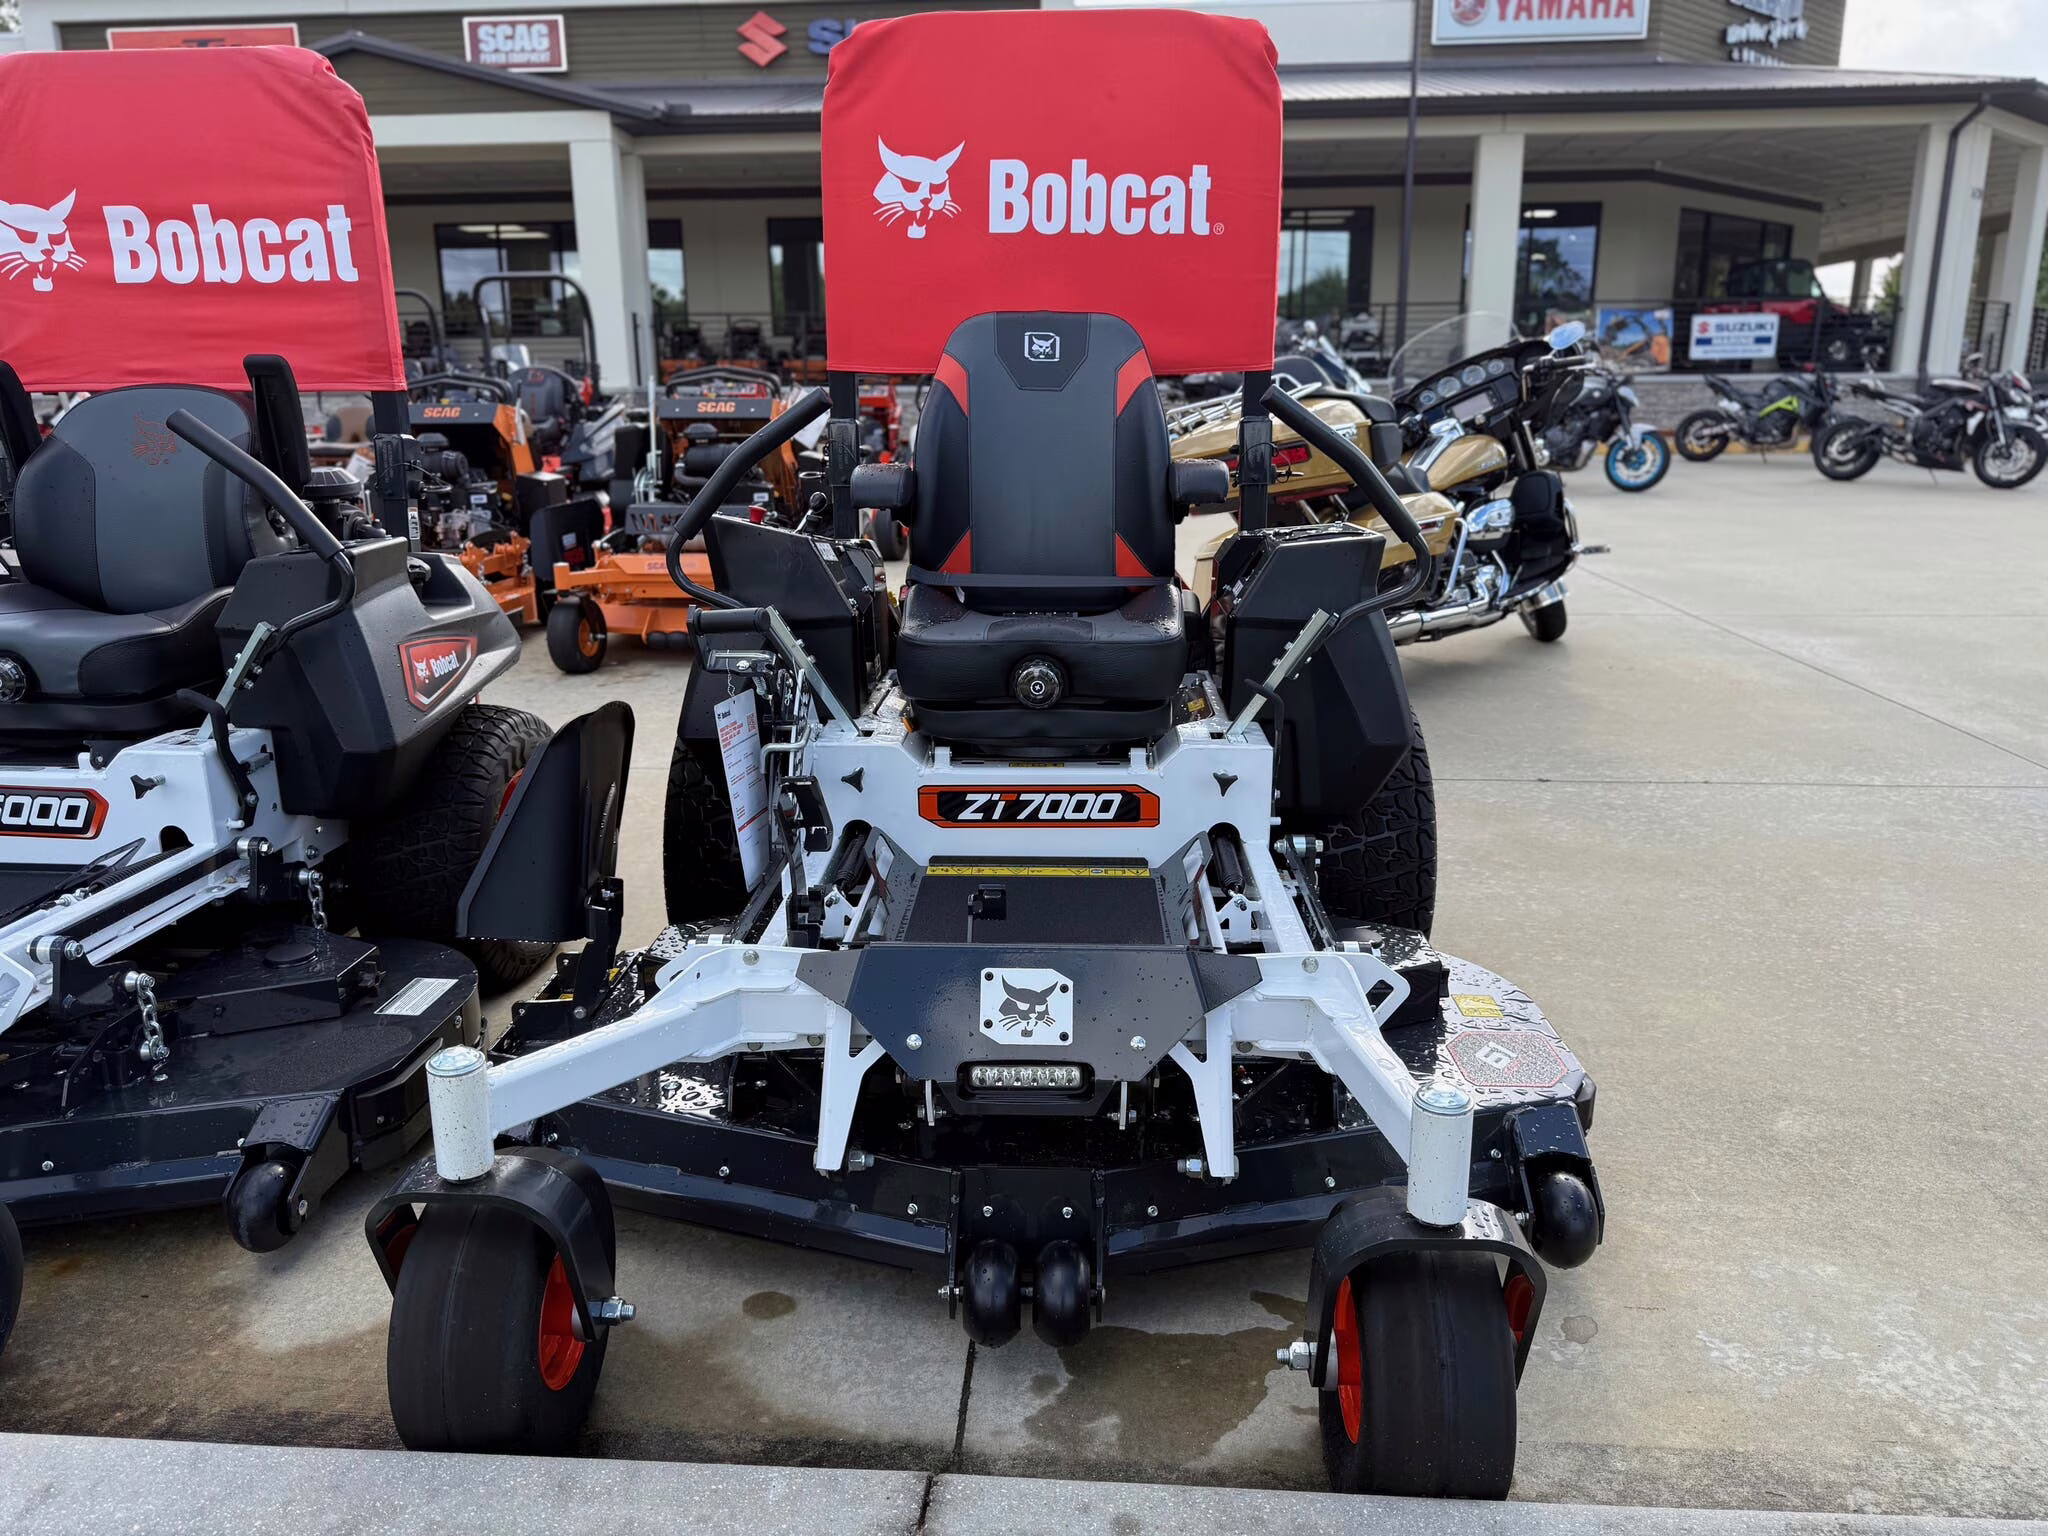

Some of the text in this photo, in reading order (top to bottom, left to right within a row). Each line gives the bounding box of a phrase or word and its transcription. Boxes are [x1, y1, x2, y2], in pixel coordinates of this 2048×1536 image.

[1496, 0, 1635, 21] YAMAHA
[477, 23, 550, 52] SCAG
[988, 158, 1211, 236] Bobcat
[102, 203, 359, 285] Bobcat
[1714, 322, 1775, 333] SUZUKI
[423, 406, 461, 418] SCAG
[697, 401, 736, 413] SCAG
[429, 649, 460, 678] Bobcat
[0, 794, 89, 828] 000
[1017, 793, 1123, 820] 7000
